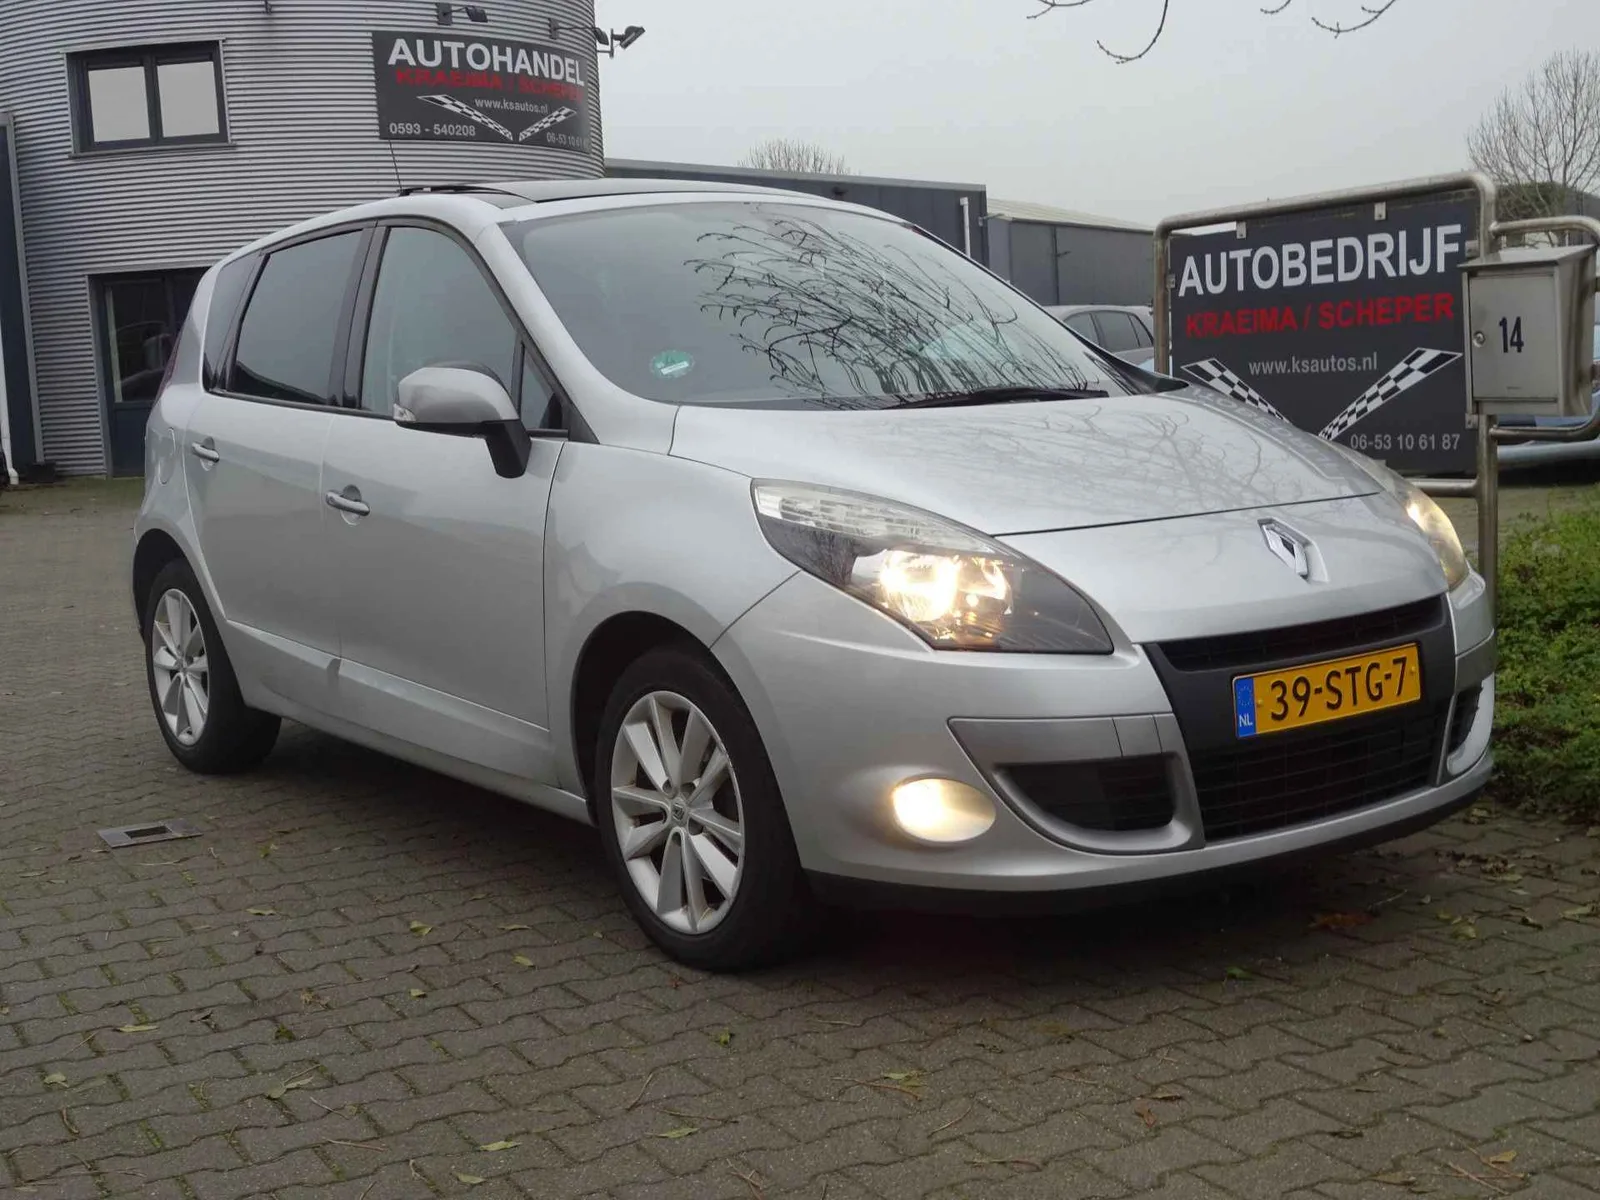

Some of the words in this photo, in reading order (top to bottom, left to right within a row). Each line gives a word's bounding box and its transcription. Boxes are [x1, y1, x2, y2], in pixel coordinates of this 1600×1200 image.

[388, 38, 585, 86] AUTOHANDEL
[475, 98, 548, 114] www.ksautos.nl
[389, 122, 421, 135] 0593
[433, 124, 476, 137] 540208
[1178, 223, 1462, 297] AUTOBEDRIJF
[1185, 307, 1299, 340] KRAEIMA
[1303, 306, 1312, 331] /
[1318, 292, 1455, 331] SCHEPER
[1499, 316, 1524, 353] 14
[1248, 351, 1378, 376] www.ksautos.nl
[1350, 434, 1392, 451] 06-53
[1396, 434, 1414, 451] 10
[1418, 433, 1437, 450] 61
[1441, 433, 1461, 450] 87
[1270, 656, 1407, 722] 39-STG-7
[1239, 712, 1253, 728] NL
